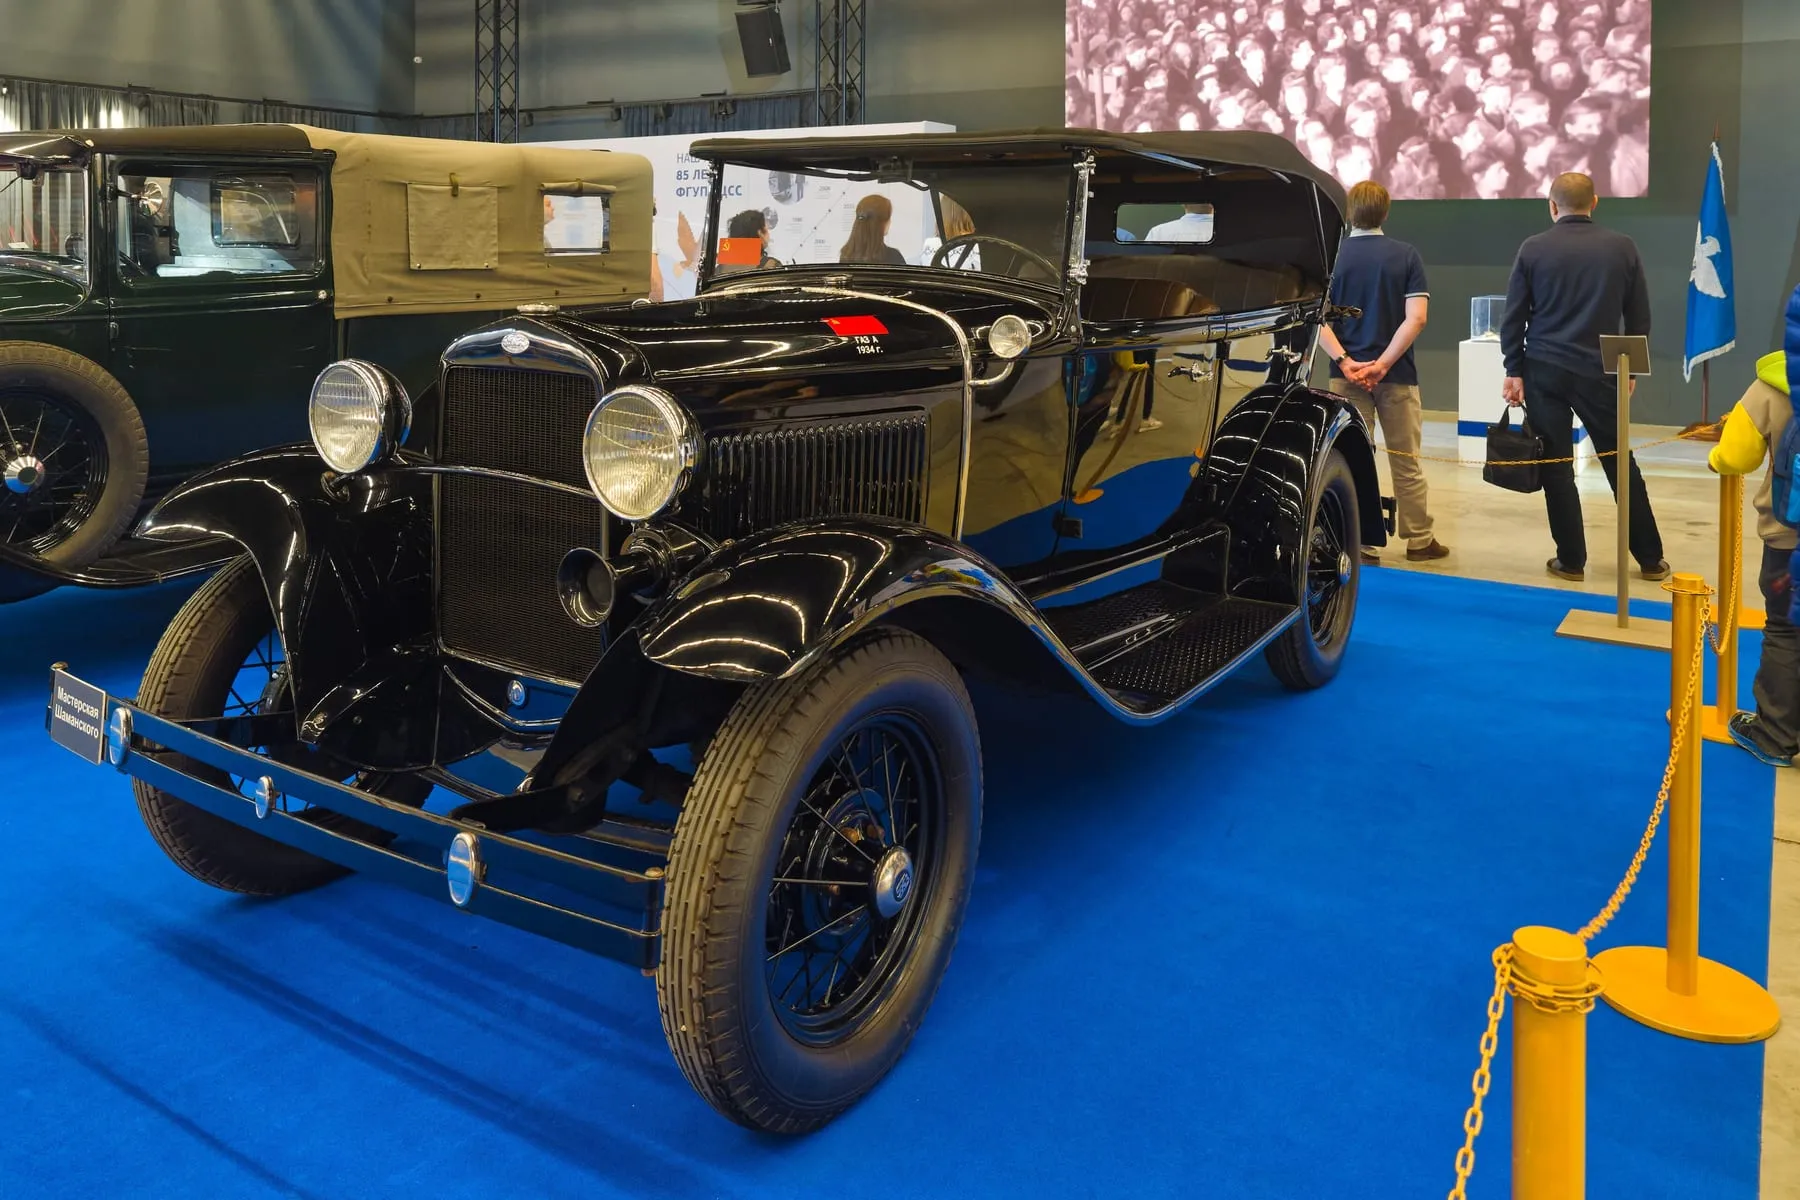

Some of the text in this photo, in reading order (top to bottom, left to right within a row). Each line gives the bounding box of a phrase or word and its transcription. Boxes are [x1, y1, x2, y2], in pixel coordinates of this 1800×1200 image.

[676, 169, 709, 180] 85 ЛЕ
[676, 185, 743, 198] ФГУП ЦСС
[854, 336, 879, 344] ГАЗ А
[856, 345, 875, 354] 1934
[57, 686, 99, 720] Мастерская
[54, 703, 99, 738] Шаманского
